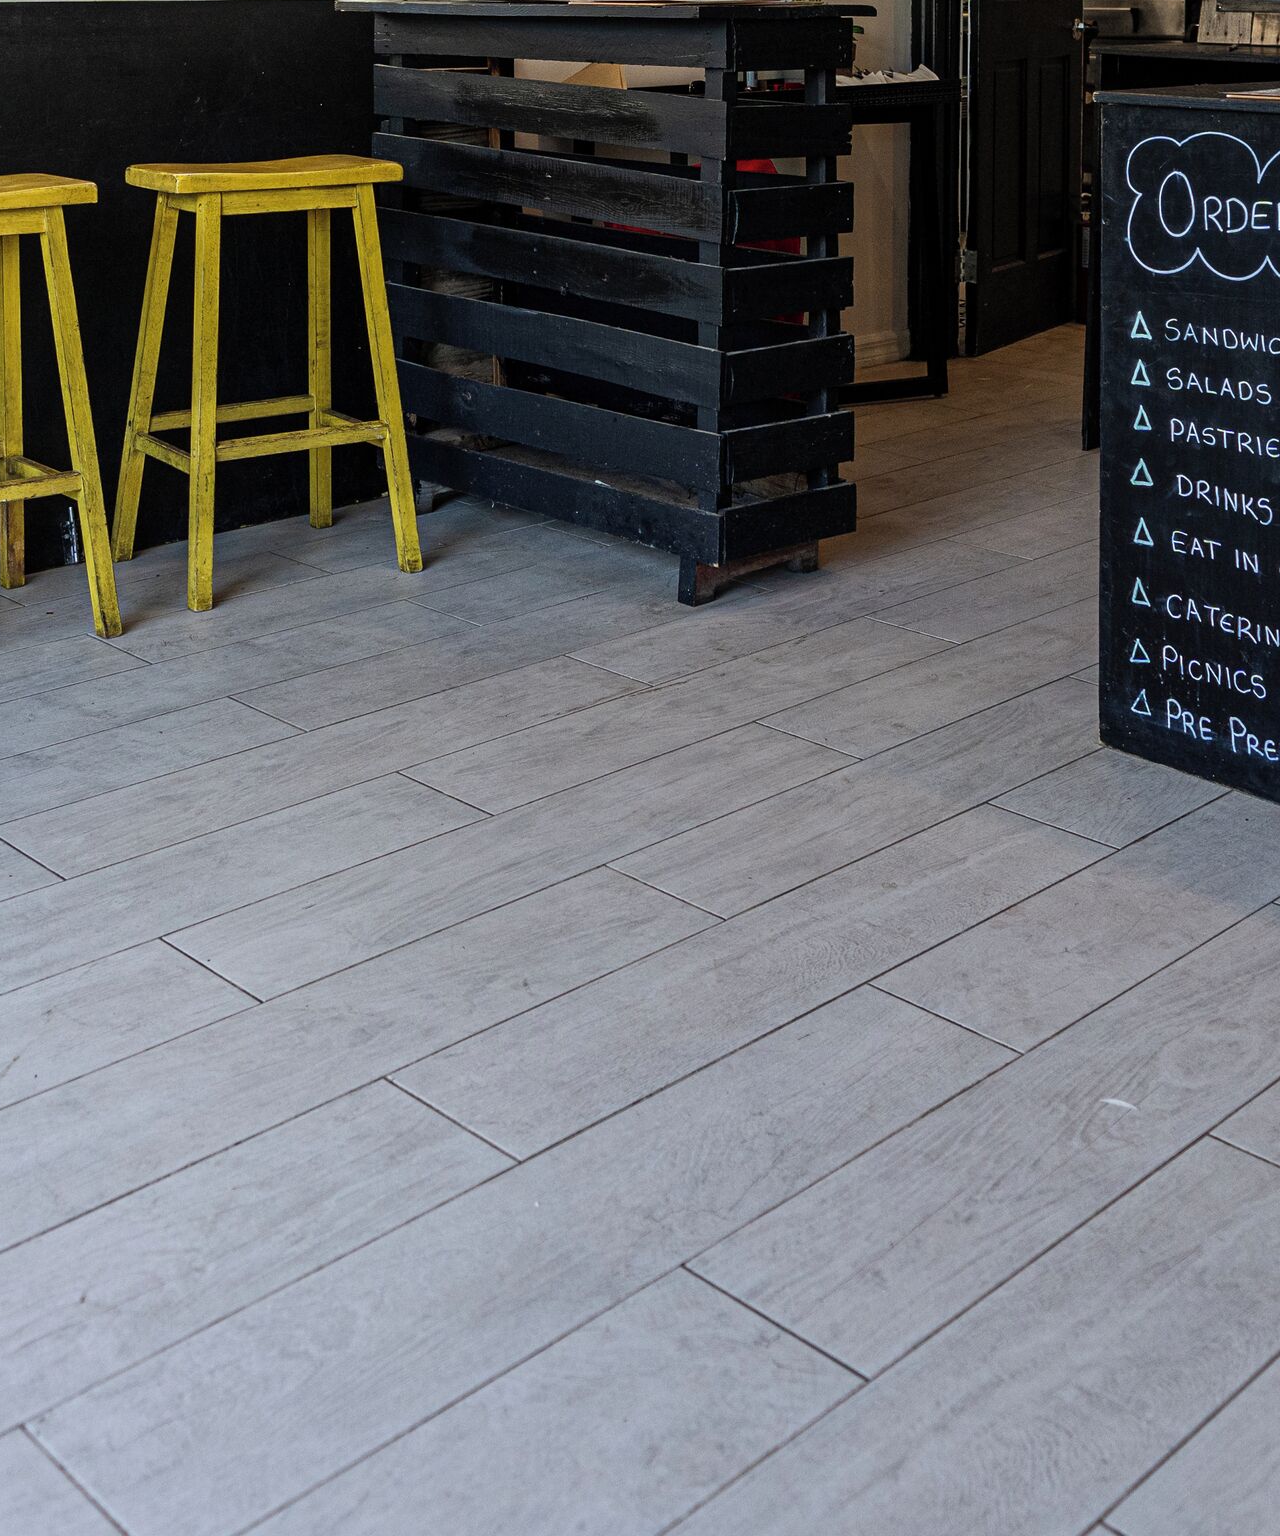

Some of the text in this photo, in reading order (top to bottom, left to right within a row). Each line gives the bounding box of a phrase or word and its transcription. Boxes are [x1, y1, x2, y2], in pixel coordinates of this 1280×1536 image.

[1166, 368, 1273, 406] SALADS
[1176, 473, 1275, 526] DRINKS
[1170, 529, 1223, 561] EAT
[1235, 549, 1259, 575] IN
[1161, 644, 1268, 700] PICNICS
[1166, 698, 1214, 744] PRE
